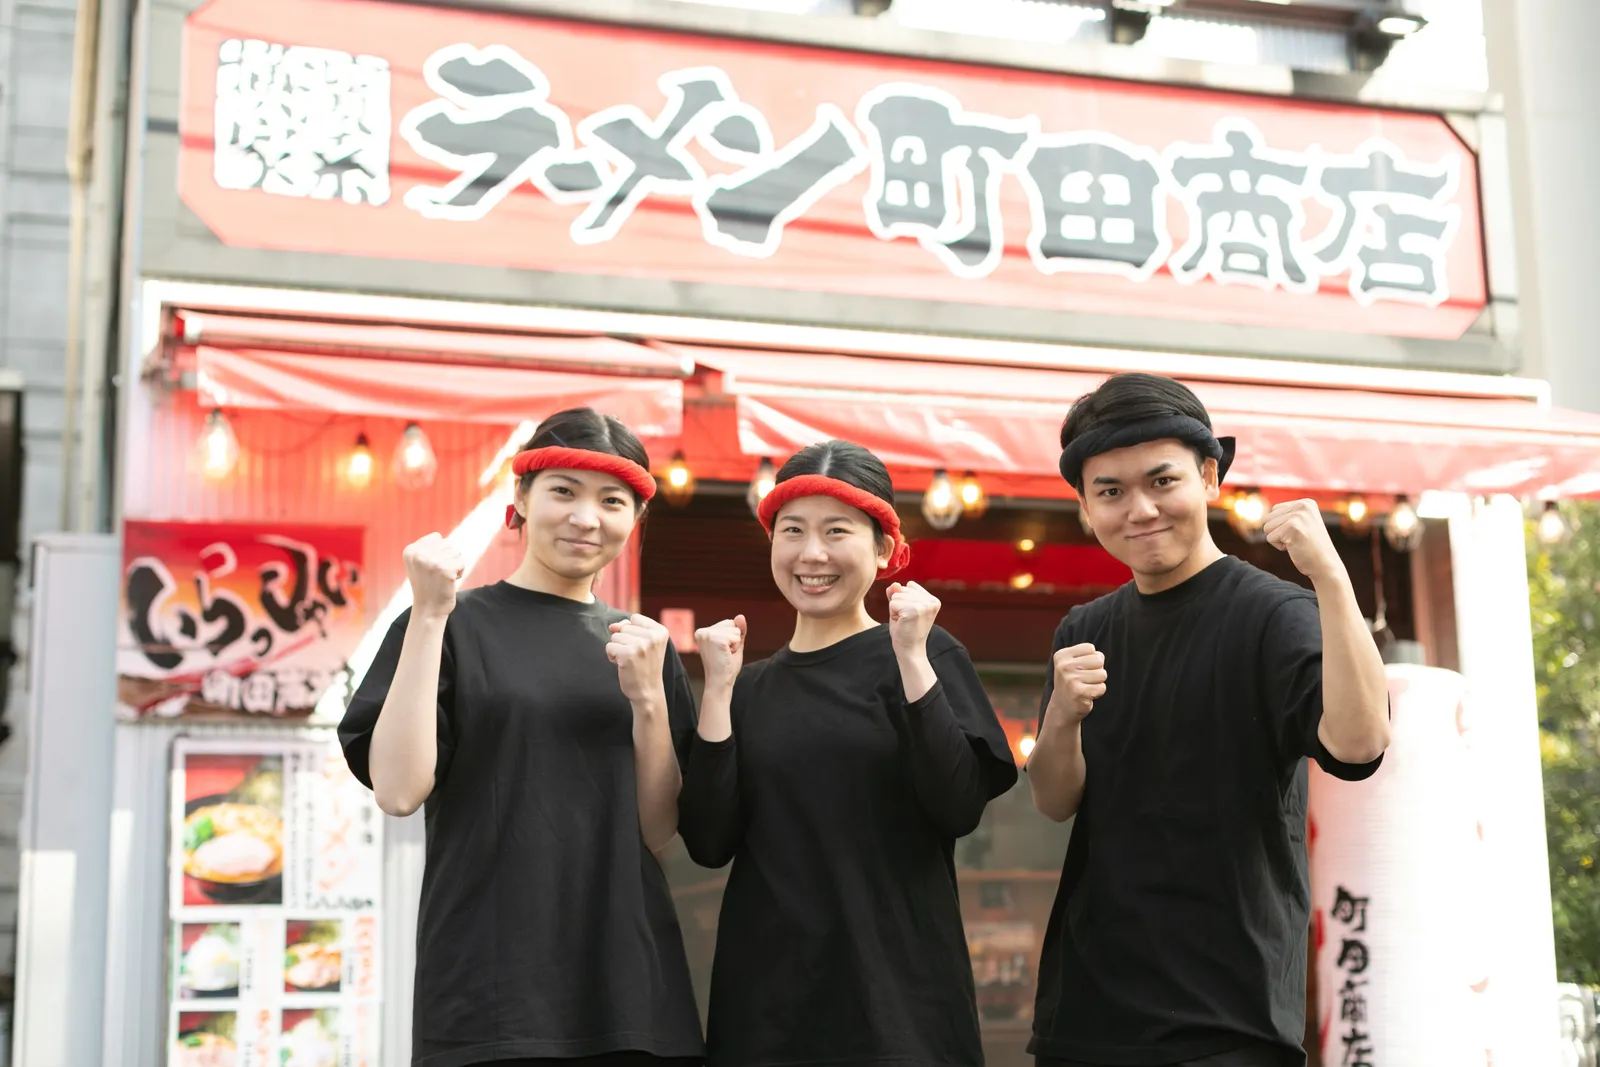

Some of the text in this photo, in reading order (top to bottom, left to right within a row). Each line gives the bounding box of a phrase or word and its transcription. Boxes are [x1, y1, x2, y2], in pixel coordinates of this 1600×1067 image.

[404, 44, 1458, 305] ラーメン町田商店
